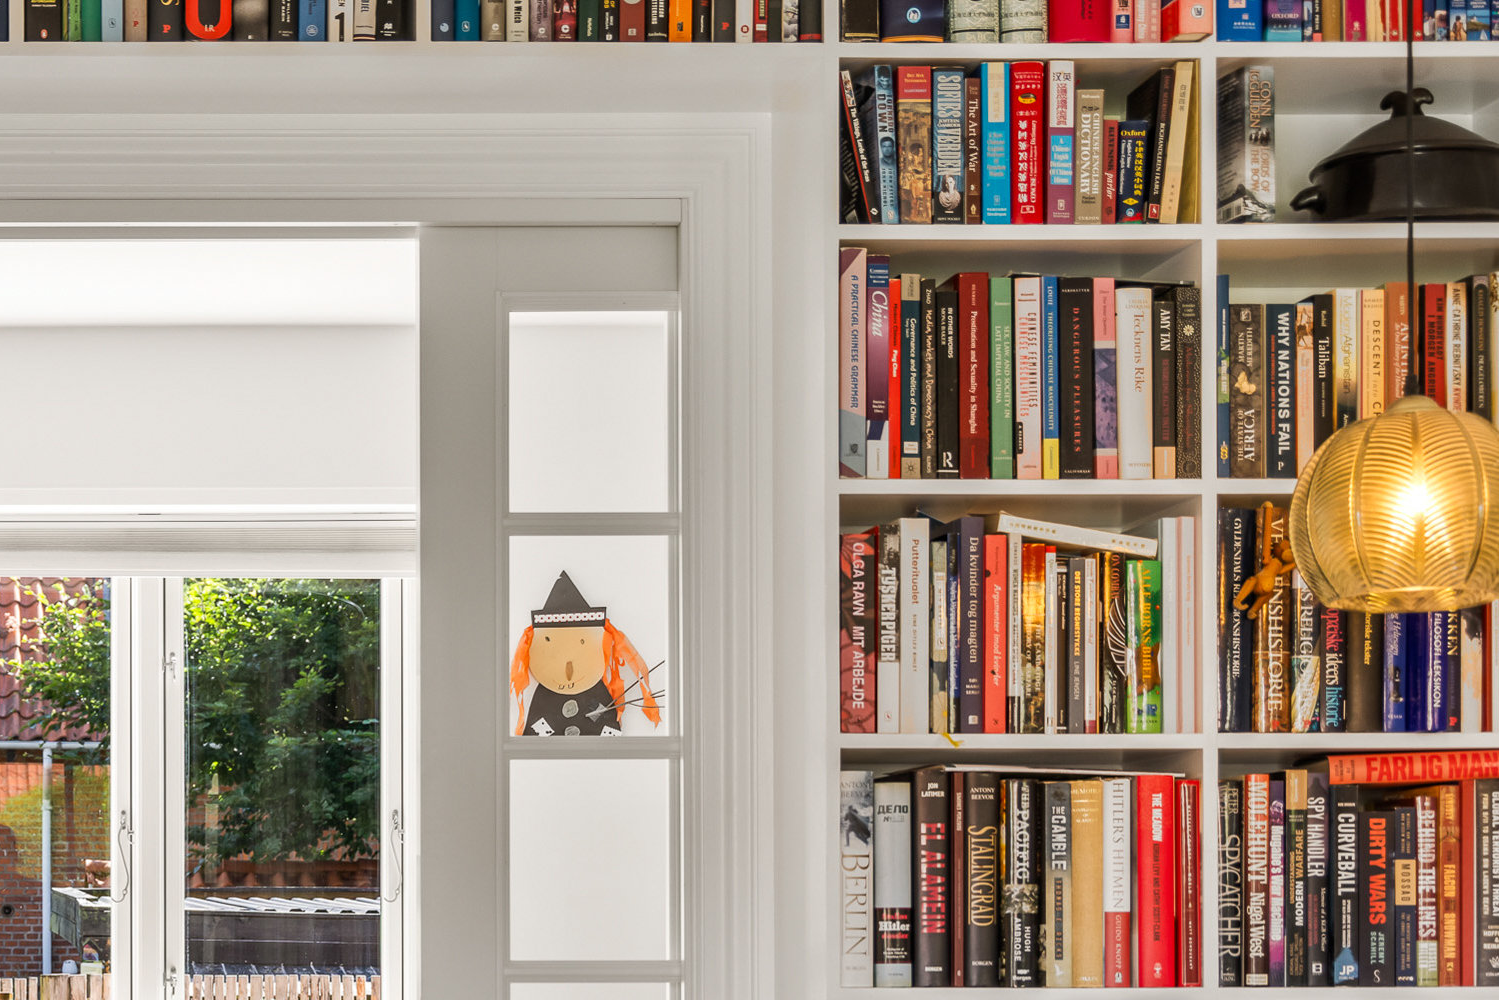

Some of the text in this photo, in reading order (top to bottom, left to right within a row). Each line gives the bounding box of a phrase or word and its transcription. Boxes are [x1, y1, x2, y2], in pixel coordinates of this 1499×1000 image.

[937, 75, 963, 176] SOFIES VERDEN
[969, 99, 979, 172] The Art of War
[1250, 70, 1261, 128] IGGULDEN
[1260, 81, 1271, 116] CONN
[1079, 113, 1091, 195] DICTIONARY
[851, 329, 859, 362] CHINESE
[871, 290, 887, 337] China
[1160, 309, 1170, 351] AMY TAN
[851, 366, 859, 408] GRAMMAR
[1072, 308, 1081, 452] DANGEROUS PLEASURES
[1277, 313, 1290, 454] WHY NATIONS FAIL
[1318, 337, 1329, 378] Taliban
[852, 542, 865, 709] OLGA RAVN MIT ARBEJDE
[881, 568, 896, 661] TYSKERPIGER
[966, 537, 979, 662] Da kvinder tog magten
[1307, 797, 1325, 820] SPY
[1365, 755, 1442, 782] FARLIG
[921, 823, 945, 933] EL ALAMEIN
[967, 825, 997, 926] STALINGRAD
[1051, 815, 1066, 870] GAMBLE
[1113, 782, 1124, 908] HITLER'S HITMEN
[1247, 781, 1267, 958] MOLEHUNT Nigel West
[1307, 824, 1325, 877] HANDLER
[1337, 813, 1355, 896] CURVEBALL
[1369, 818, 1386, 925] DIRTY WARS
[1401, 864, 1411, 902] MOSSAD
[841, 852, 870, 955] BERLIN
